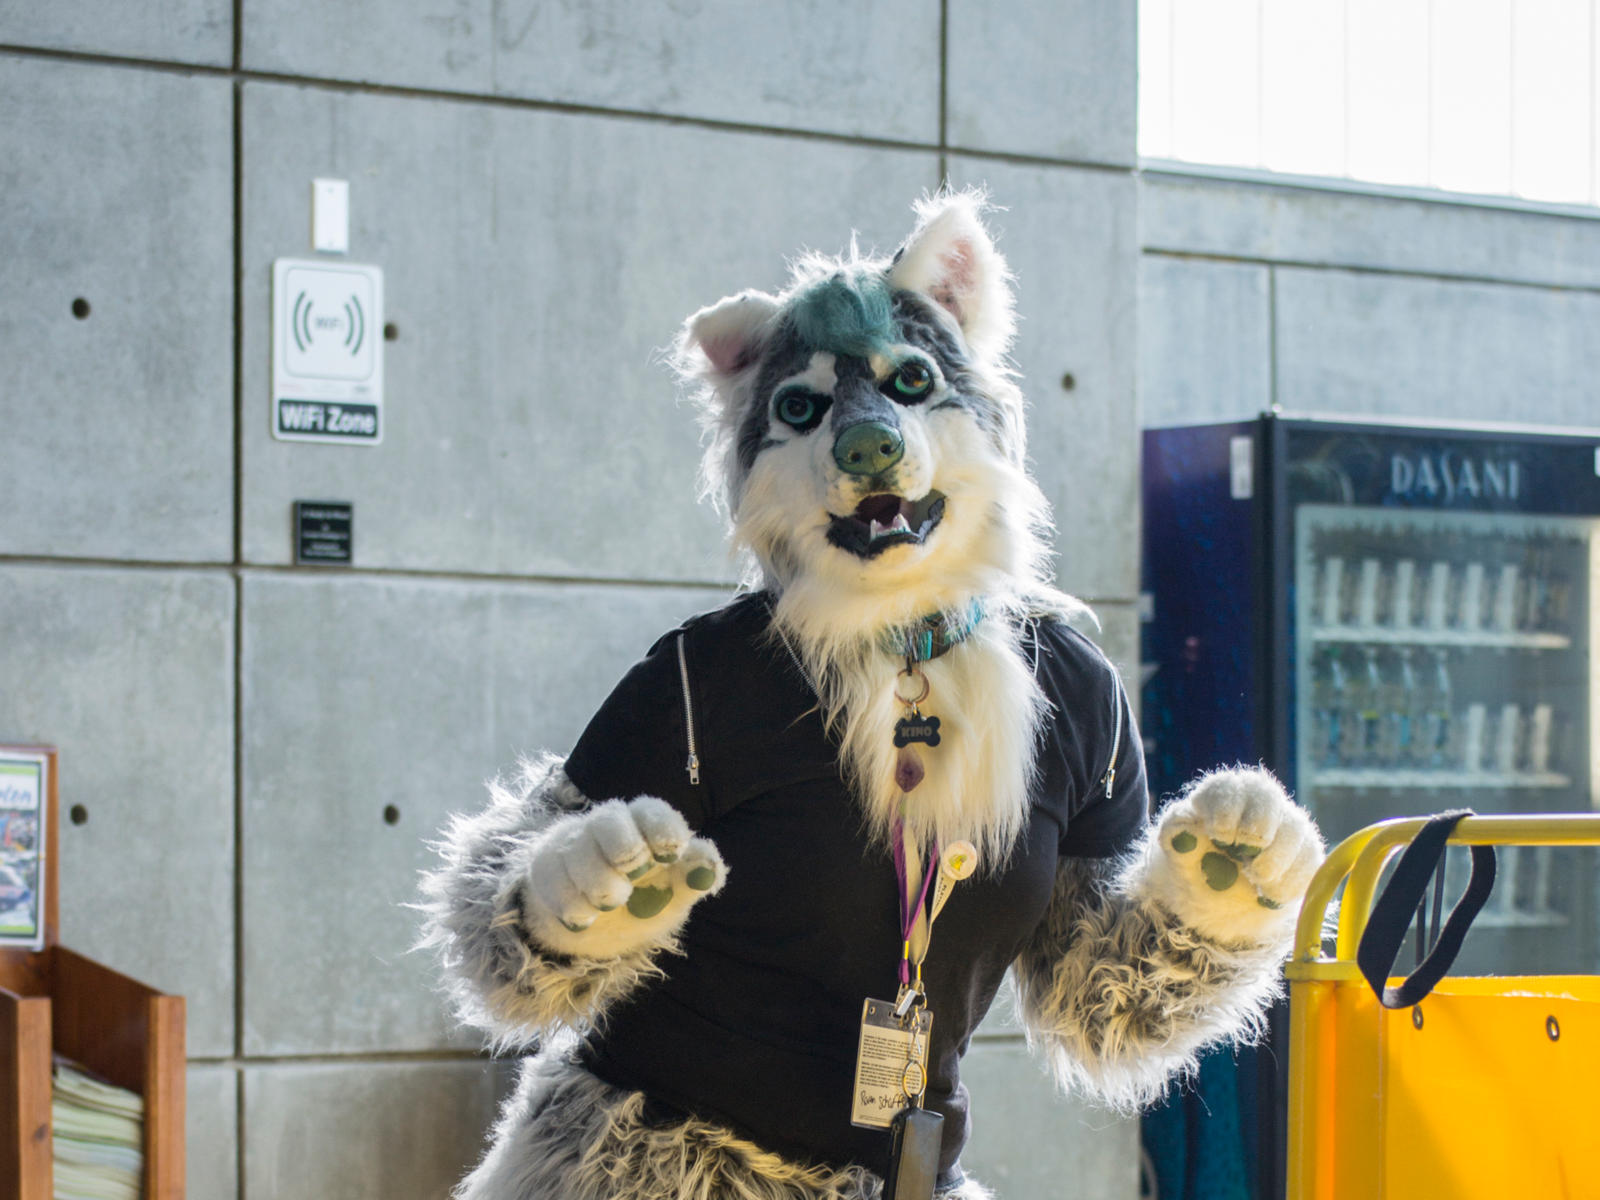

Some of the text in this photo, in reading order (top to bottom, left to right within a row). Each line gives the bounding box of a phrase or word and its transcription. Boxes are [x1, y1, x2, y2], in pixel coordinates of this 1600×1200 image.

[280, 402, 377, 434] WiFi Zone
[1390, 453, 1519, 500] DASANI
